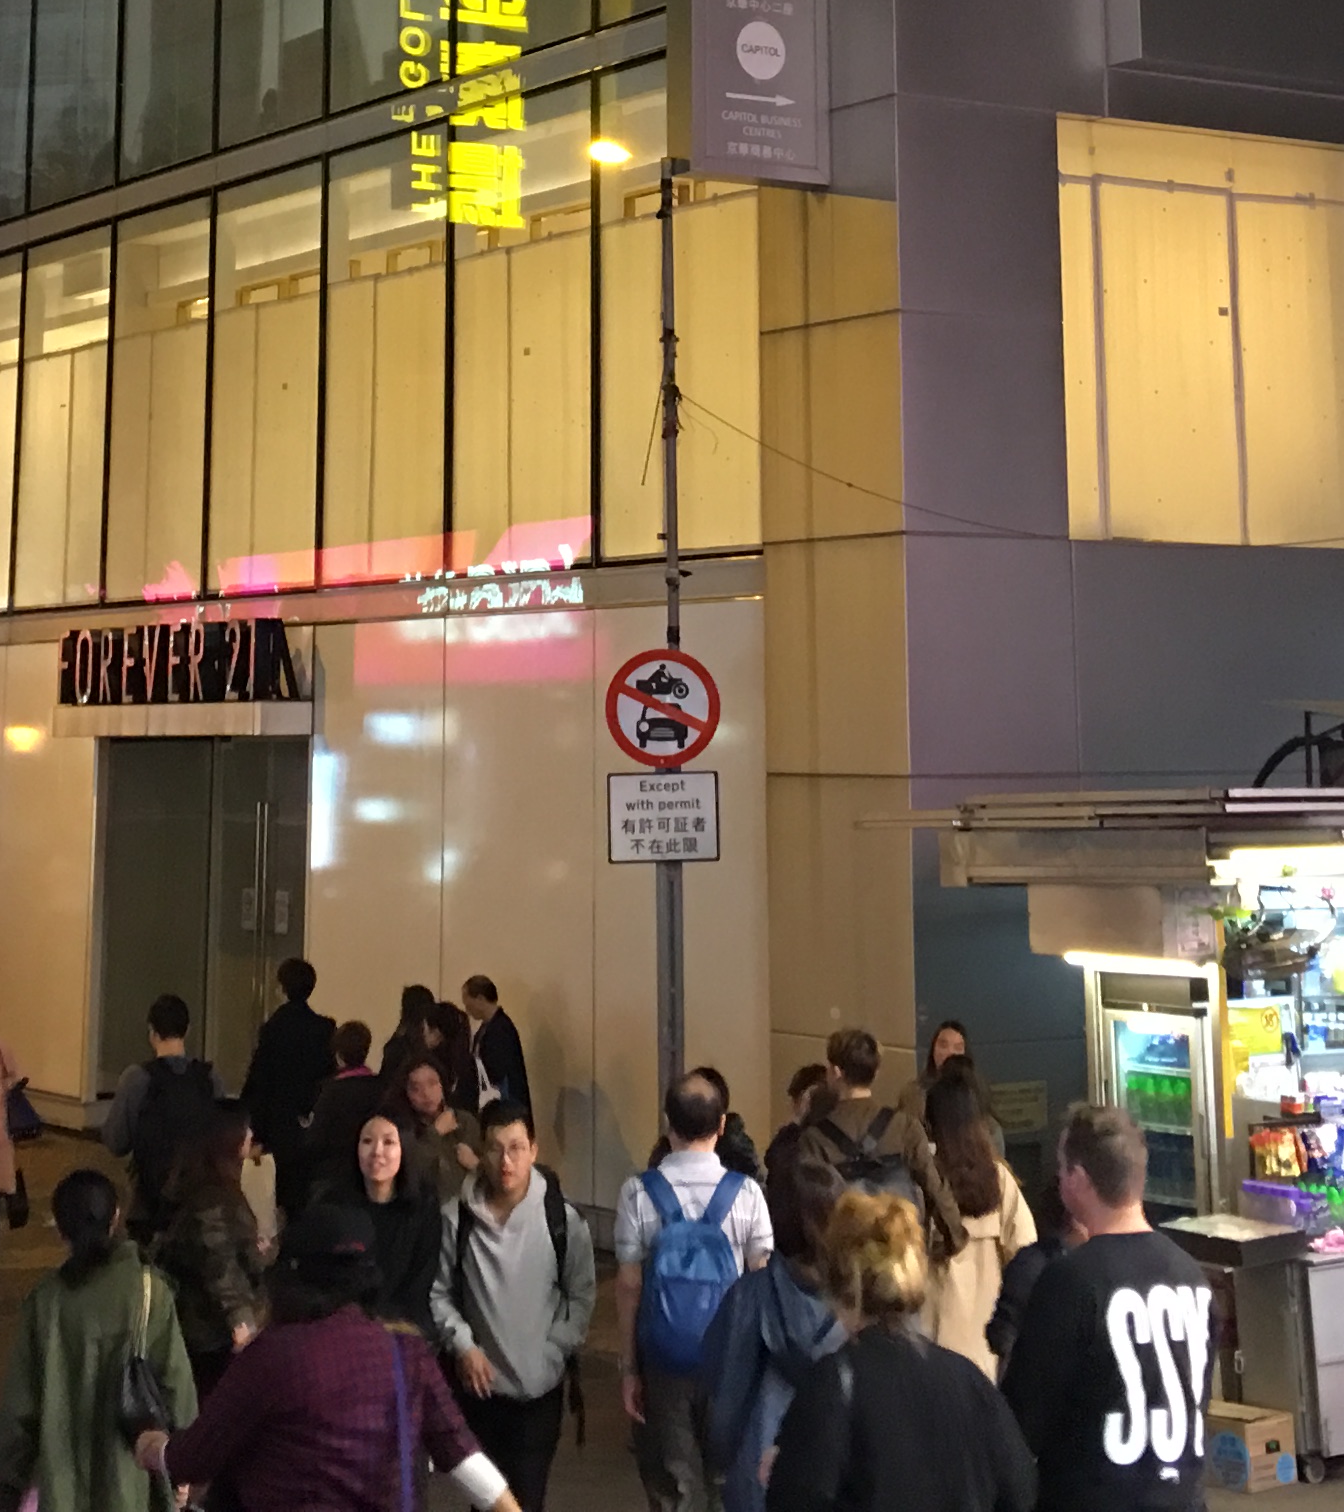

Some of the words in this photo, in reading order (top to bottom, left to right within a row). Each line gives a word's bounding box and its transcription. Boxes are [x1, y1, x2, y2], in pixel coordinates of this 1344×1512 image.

[741, 43, 781, 58] CAPITOL
[721, 110, 759, 124] CAPITOL
[760, 113, 803, 128] BUSINESS
[742, 125, 783, 139] CENTRES
[60, 618, 205, 705] FOREVER
[639, 780, 685, 793] Except
[625, 799, 654, 811] with
[658, 798, 701, 812] permit
[630, 837, 698, 854] 不在此限
